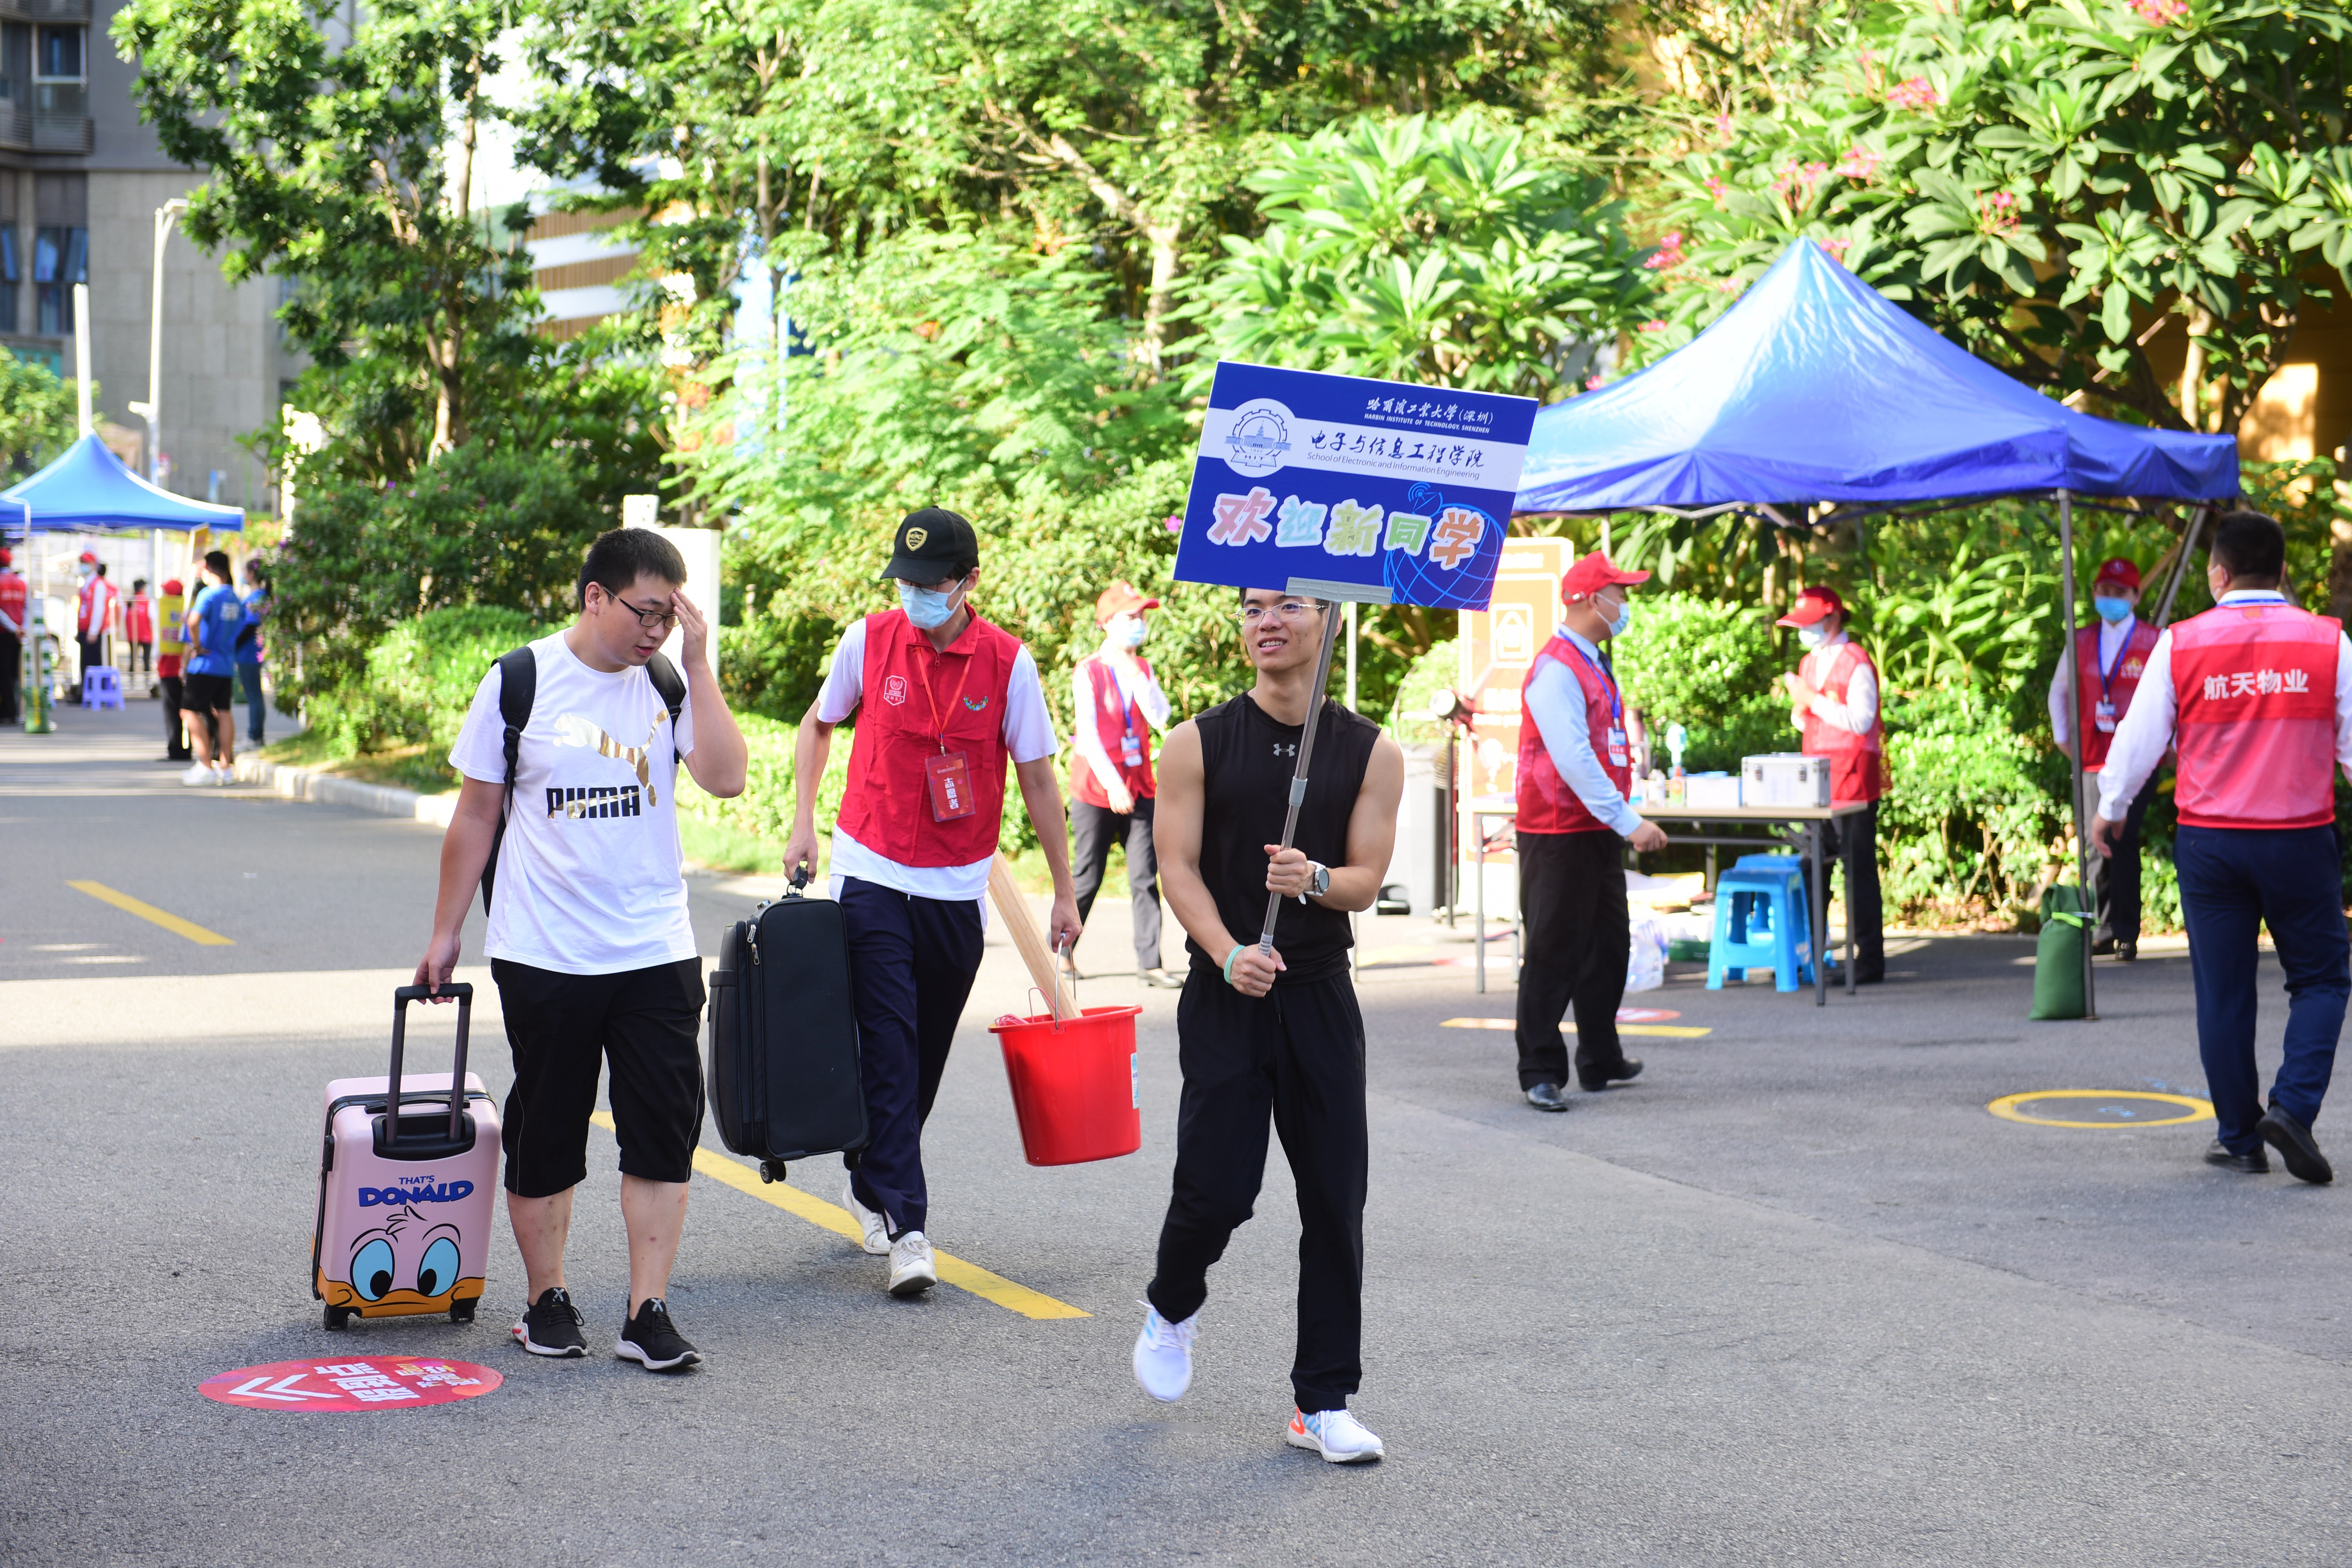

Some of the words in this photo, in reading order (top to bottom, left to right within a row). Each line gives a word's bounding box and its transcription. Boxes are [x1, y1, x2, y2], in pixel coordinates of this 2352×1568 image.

[1364, 413, 1385, 421] HARBIN
[1386, 415, 1413, 424] INSTITUTE
[1424, 420, 1460, 430] TECHNOLOGY,
[1461, 425, 1490, 434] SHENZHEN
[1307, 452, 1332, 462] School
[1341, 456, 1378, 467] Electronic
[1378, 461, 1392, 469] and
[1392, 461, 1436, 474] Information
[1436, 467, 1480, 481] Engineering
[1208, 487, 1484, 570] 欢迎新同学
[2203, 669, 2309, 701] 航天物业
[546, 785, 640, 819] PUMA
[943, 777, 960, 810] 志愿者
[358, 1180, 474, 1207] DONALD
[398, 1175, 435, 1185] THAT'S
[313, 1362, 421, 1402] 报到点
